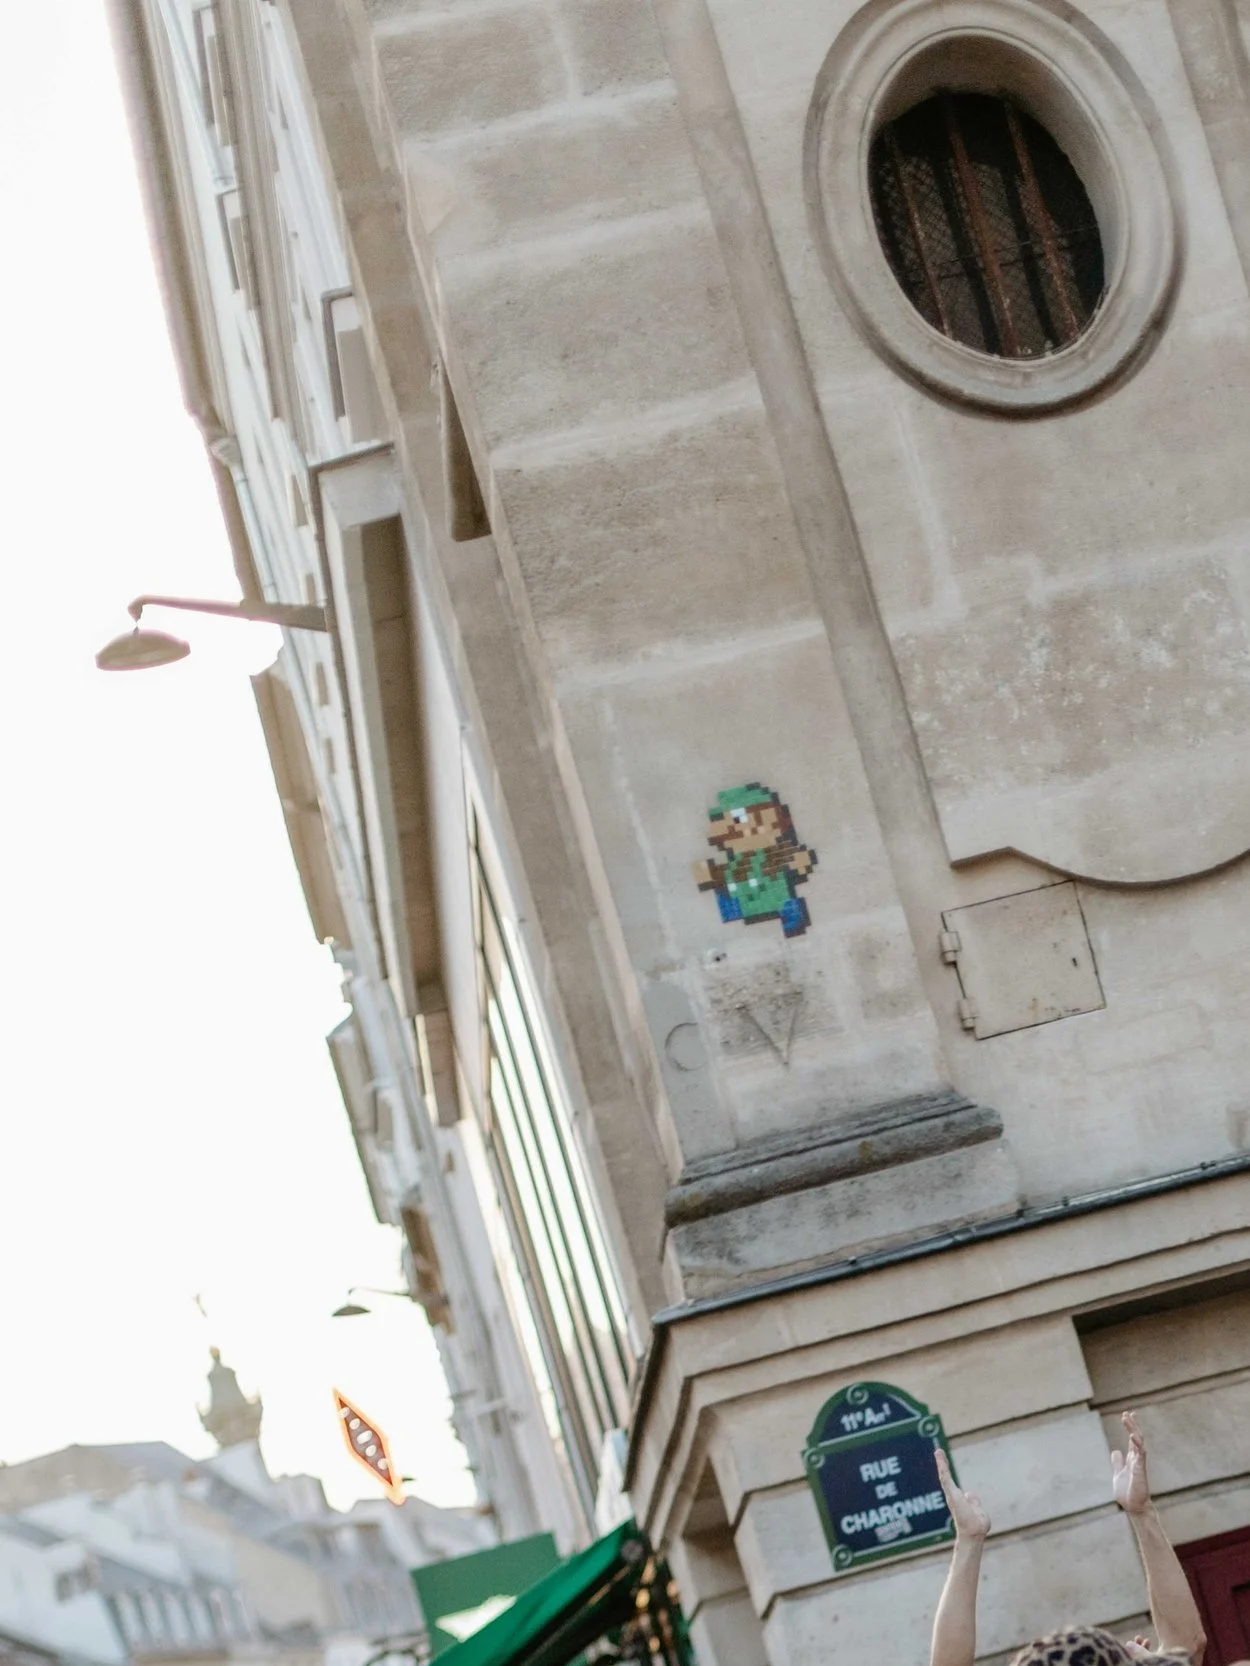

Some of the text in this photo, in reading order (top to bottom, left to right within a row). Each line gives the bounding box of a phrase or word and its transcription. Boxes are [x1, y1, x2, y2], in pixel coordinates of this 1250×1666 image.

[860, 1456, 902, 1483] RUE
[875, 1482, 898, 1499] DE
[841, 1492, 944, 1534] CHARONNE
